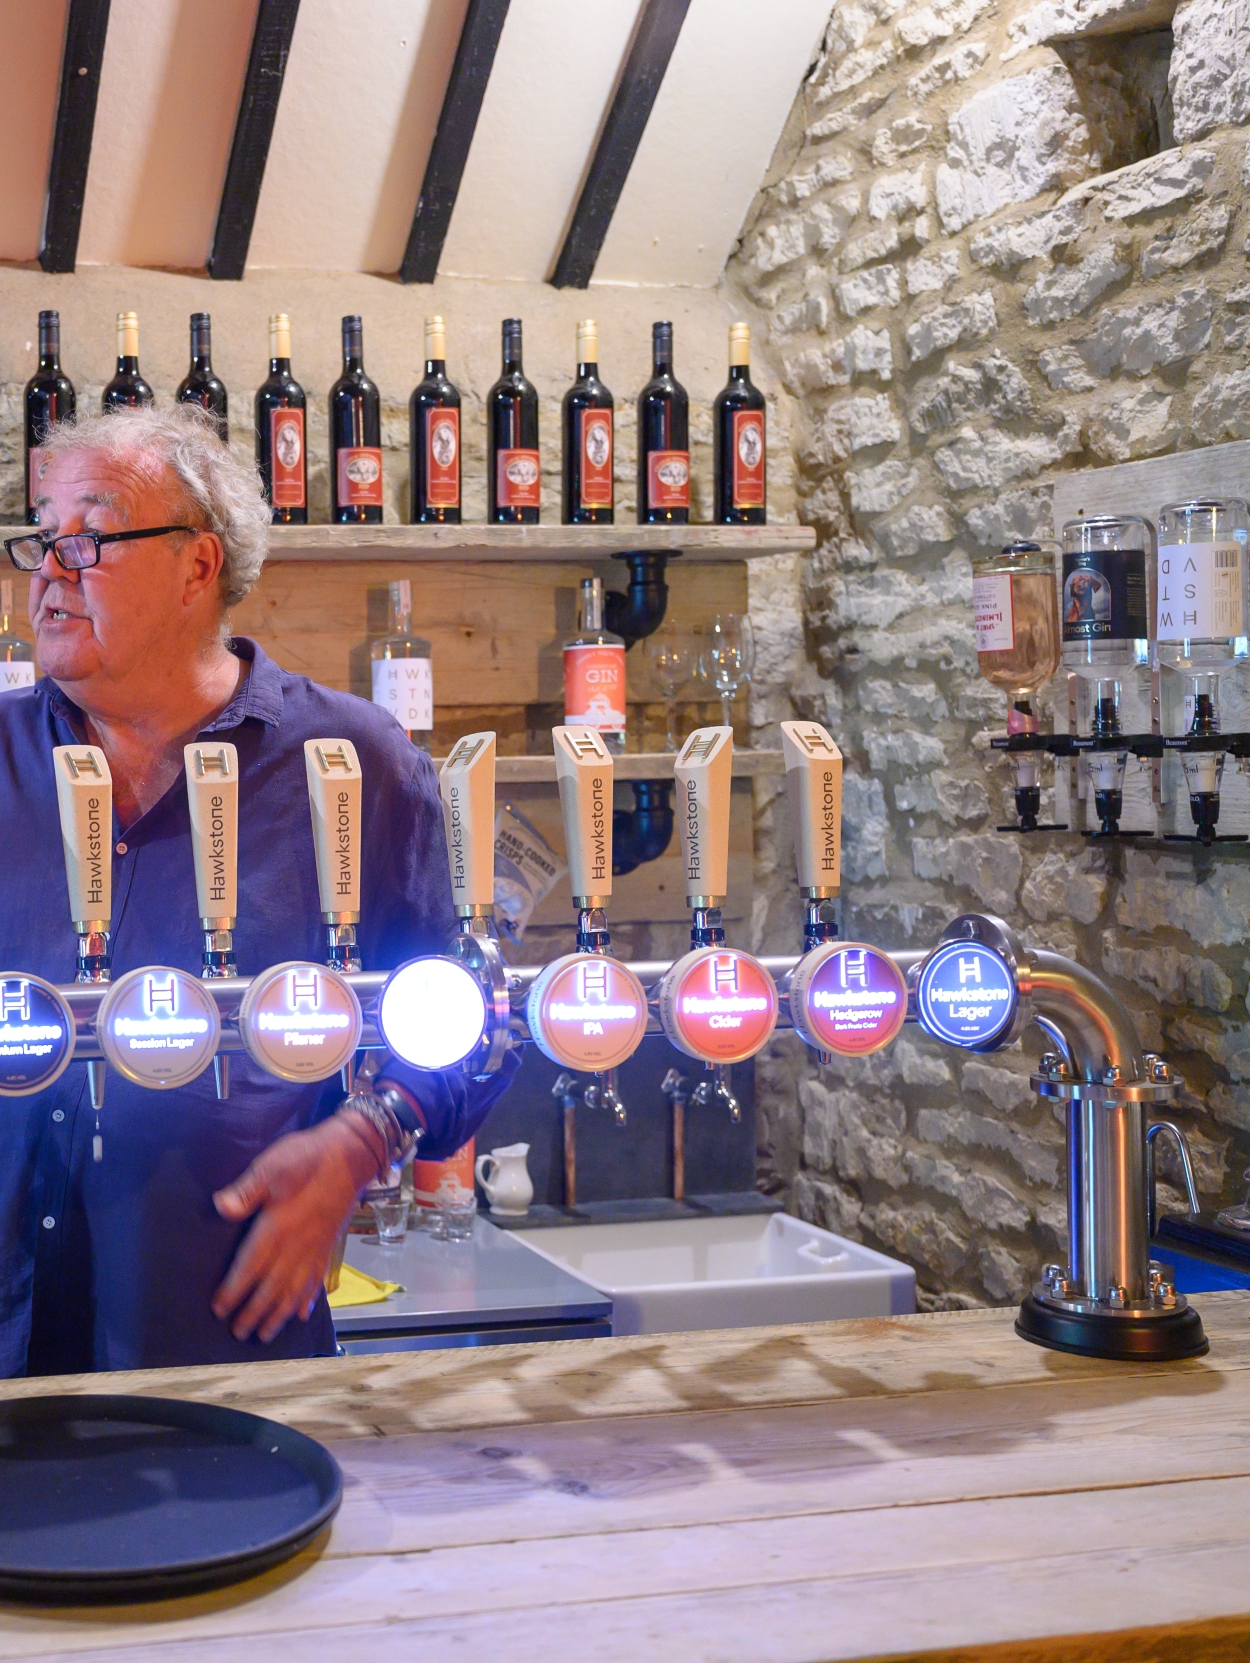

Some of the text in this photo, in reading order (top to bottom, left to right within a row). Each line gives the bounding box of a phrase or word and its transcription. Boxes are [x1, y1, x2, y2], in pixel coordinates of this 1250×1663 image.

[1092, 623, 1111, 633] Gin
[585, 669, 618, 684] GIN
[590, 777, 606, 880] Hawkstone
[821, 771, 835, 871] Hawkstone
[686, 779, 701, 880] Hawkstone
[335, 791, 352, 895] Hawkstone
[450, 787, 466, 889] Hawkstone
[86, 797, 103, 903] Hawkstone
[208, 795, 226, 900] Hawkstone
[494, 839, 525, 866] CRISPS
[499, 829, 556, 877] HAND-COOKED
[931, 987, 1009, 1002] Hawkstone
[830, 1009, 883, 1022] Hedgerow
[949, 1004, 993, 1020] Lager
[583, 1022, 604, 1036] IPA
[709, 1015, 743, 1029] Cider
[129, 1037, 195, 1049] Session Lager
[284, 1032, 326, 1046] Pilsner
[23, 1043, 53, 1056] Lager
